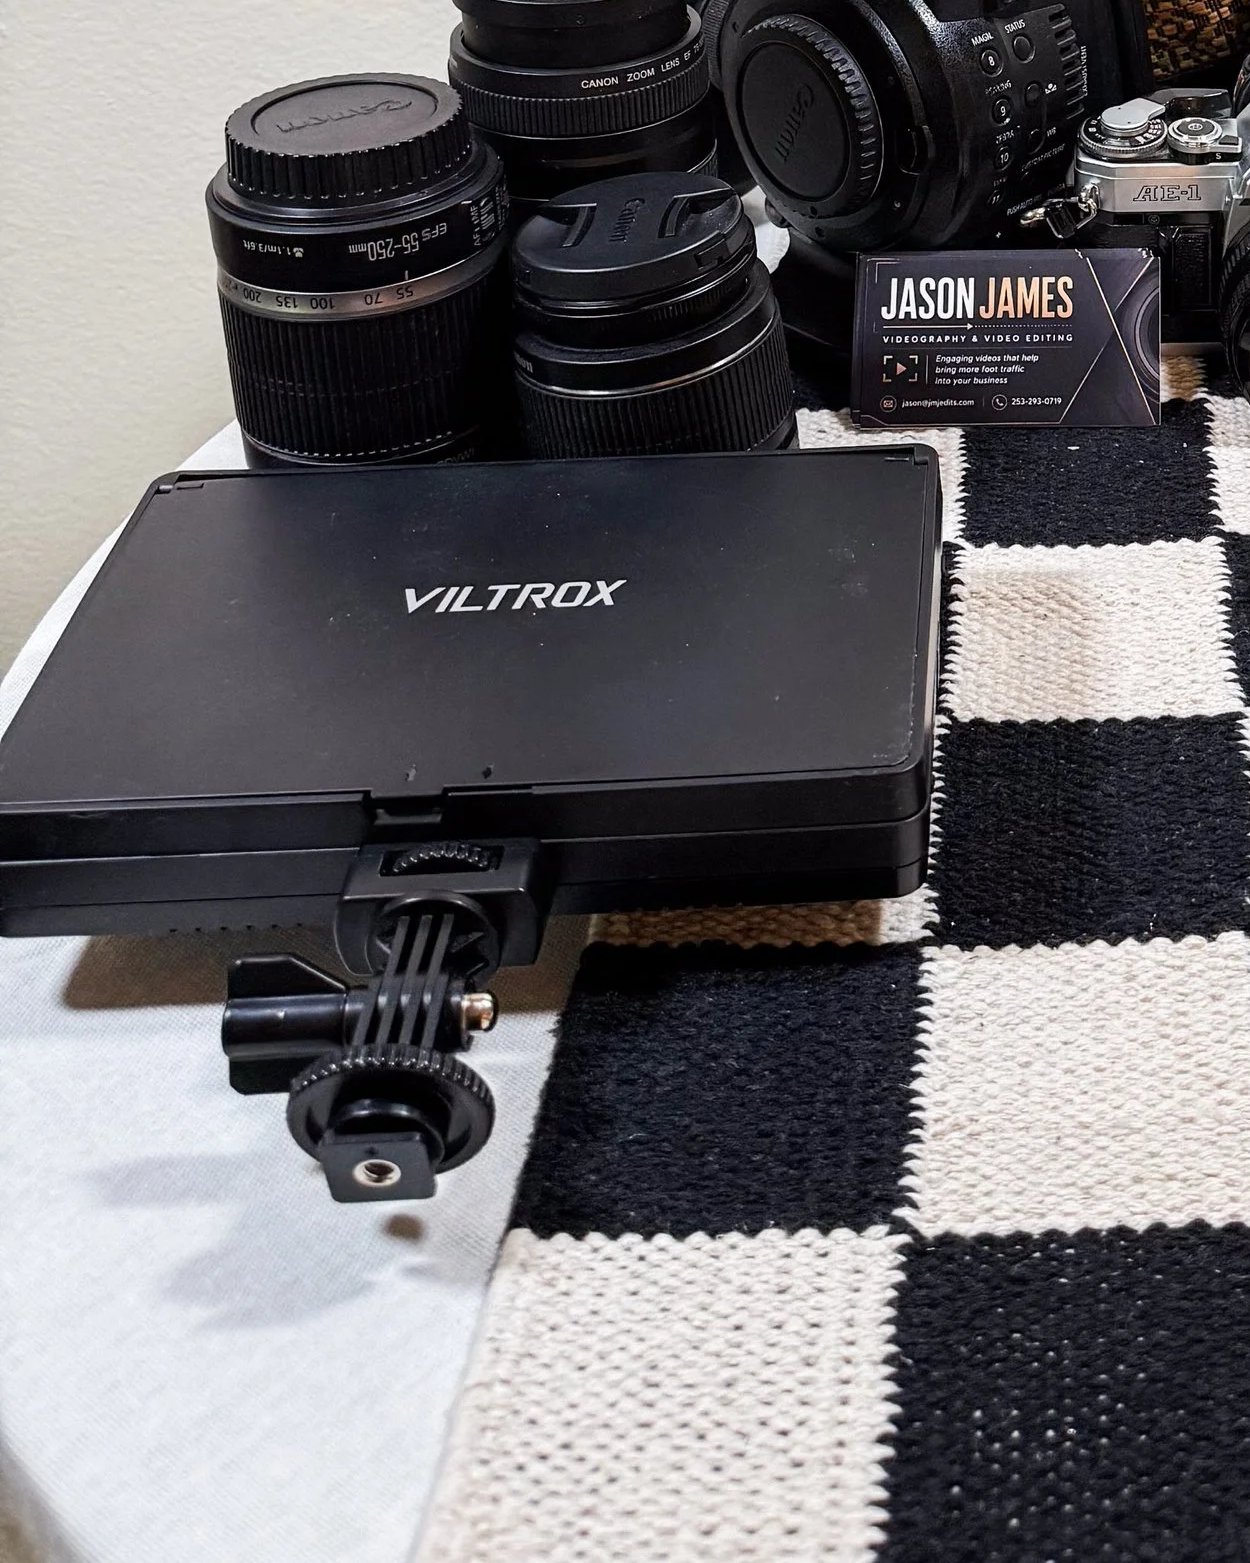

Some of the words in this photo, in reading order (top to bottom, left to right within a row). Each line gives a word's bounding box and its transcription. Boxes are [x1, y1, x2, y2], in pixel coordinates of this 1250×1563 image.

[1004, 18, 1026, 34] STATUS
[988, 56, 995, 66] 8
[581, 74, 619, 89] CANON
[626, 67, 656, 82] ZOOM
[661, 56, 680, 73] LENS
[1000, 105, 1006, 117] 9
[1215, 152, 1222, 160] S
[1132, 183, 1202, 202] AE-1
[348, 229, 420, 262] 55-250mm
[243, 287, 262, 304] 200
[364, 293, 383, 306] 70
[396, 287, 414, 301] 55
[881, 276, 975, 320] JASON
[979, 275, 1074, 320] JAMES
[276, 295, 297, 309] 135
[310, 297, 334, 310] 100
[882, 334, 966, 344] VIDEOGRAPHY
[971, 334, 979, 343] &
[984, 333, 1020, 343] VIDEO
[1025, 333, 1073, 342] EDITING
[935, 354, 974, 365] Engaging
[975, 354, 1002, 363] videos
[1003, 354, 1020, 362] that
[1021, 353, 1039, 364] help
[935, 364, 957, 375] bring
[958, 366, 980, 374] more
[981, 364, 998, 374] foot
[999, 364, 1025, 374] traffic
[935, 376, 951, 385] into
[952, 377, 971, 386] your
[973, 375, 1008, 385] business
[901, 398, 975, 409] jason@jmjedits.com
[1011, 396, 1062, 406] 253-293-0719
[404, 579, 628, 614] VILTROX
